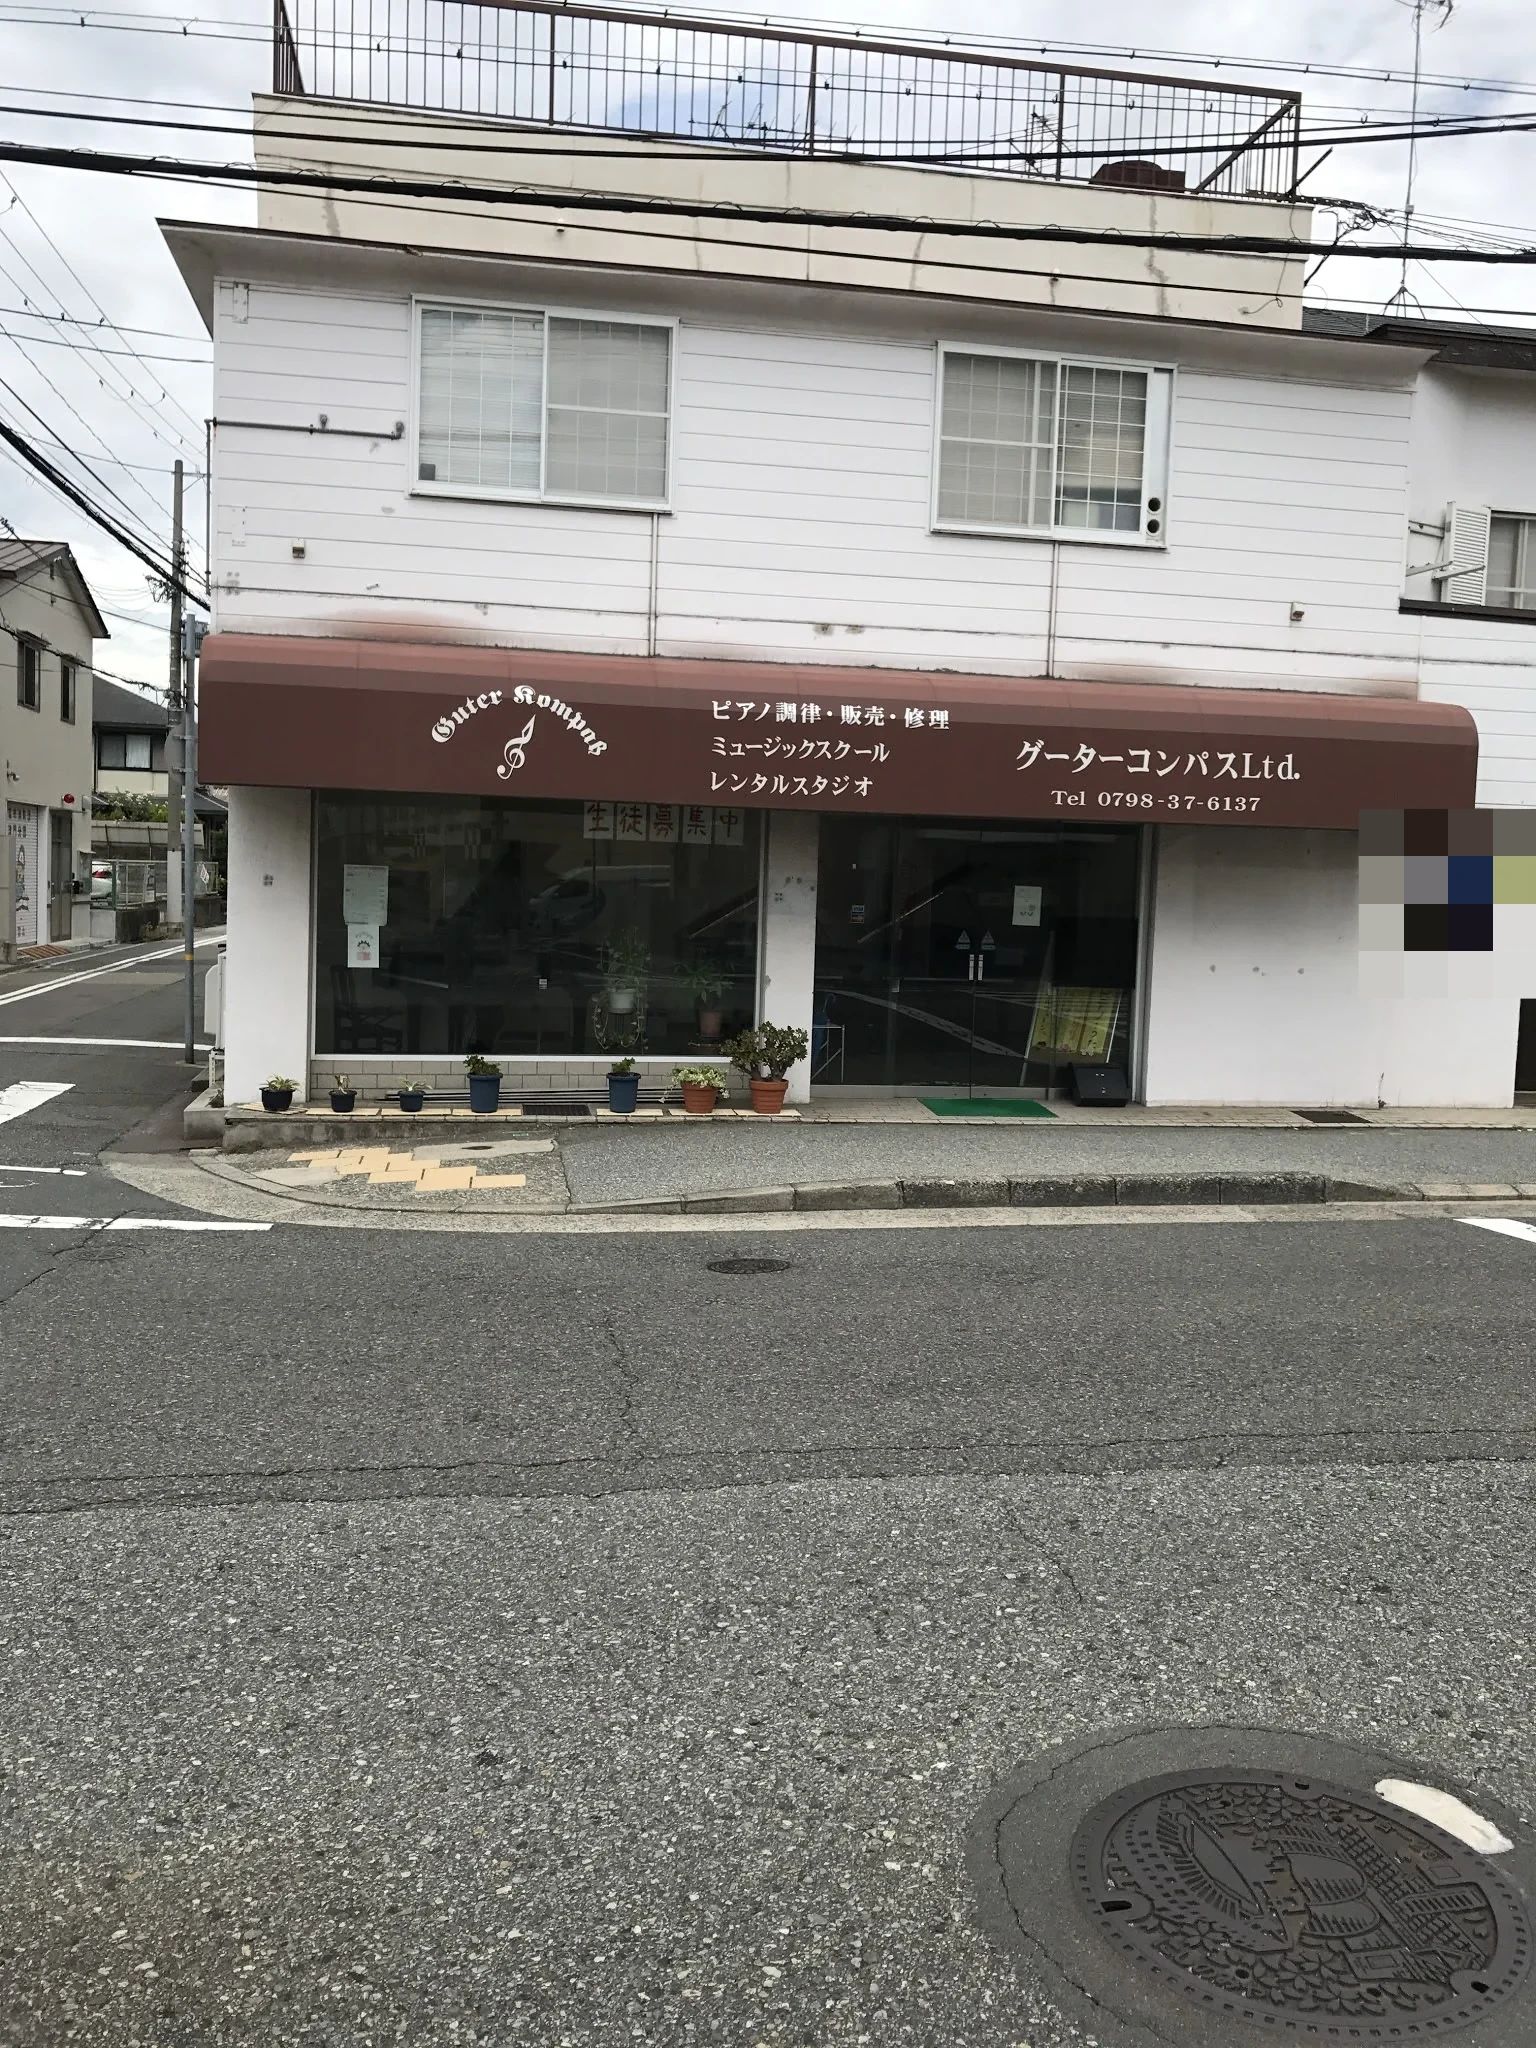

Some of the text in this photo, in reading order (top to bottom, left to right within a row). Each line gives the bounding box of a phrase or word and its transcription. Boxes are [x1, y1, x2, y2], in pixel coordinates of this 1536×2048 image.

[432, 690, 502, 743] Guter
[712, 701, 950, 730] ピアノ調律・販売・修理
[712, 737, 890, 762] ミュージックスクール
[1016, 739, 1302, 780] グーターコンパスLtd.
[710, 772, 873, 796] レンタルスタジオ
[1051, 790, 1261, 812] Tel 0798-37-6137
[587, 801, 739, 837] 生徒募集中
